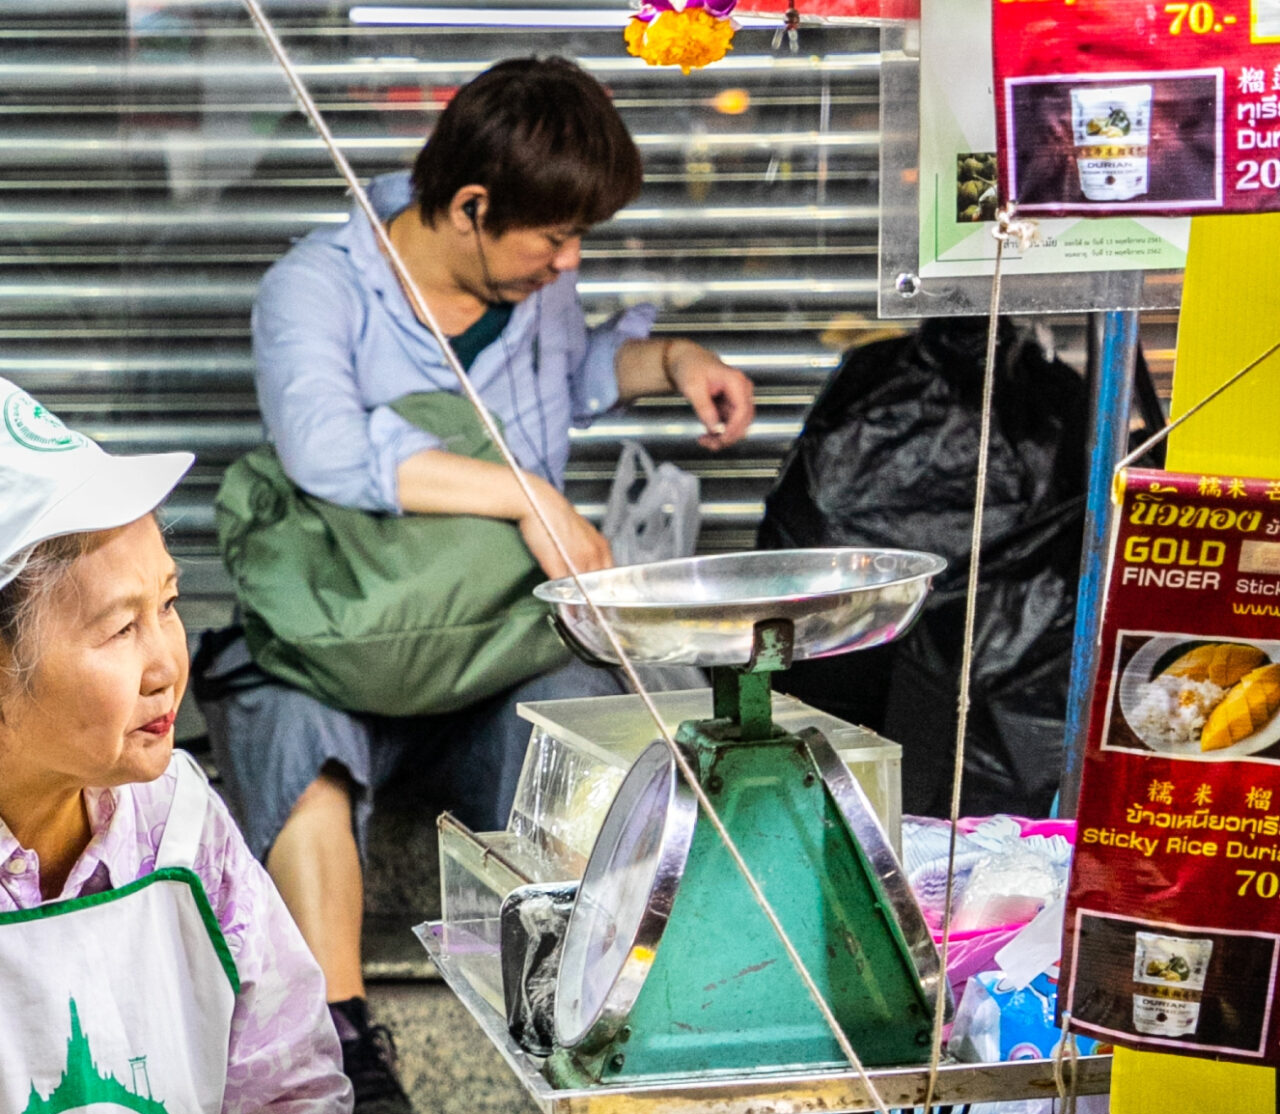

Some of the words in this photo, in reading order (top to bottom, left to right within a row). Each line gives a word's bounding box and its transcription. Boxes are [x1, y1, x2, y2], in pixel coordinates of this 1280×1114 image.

[1165, 3, 1237, 35] 70.-
[1123, 535, 1227, 567] GOLD
[1122, 566, 1221, 590] FINGER
[1083, 827, 1159, 857] Sticky
[1166, 835, 1218, 857] Rice
